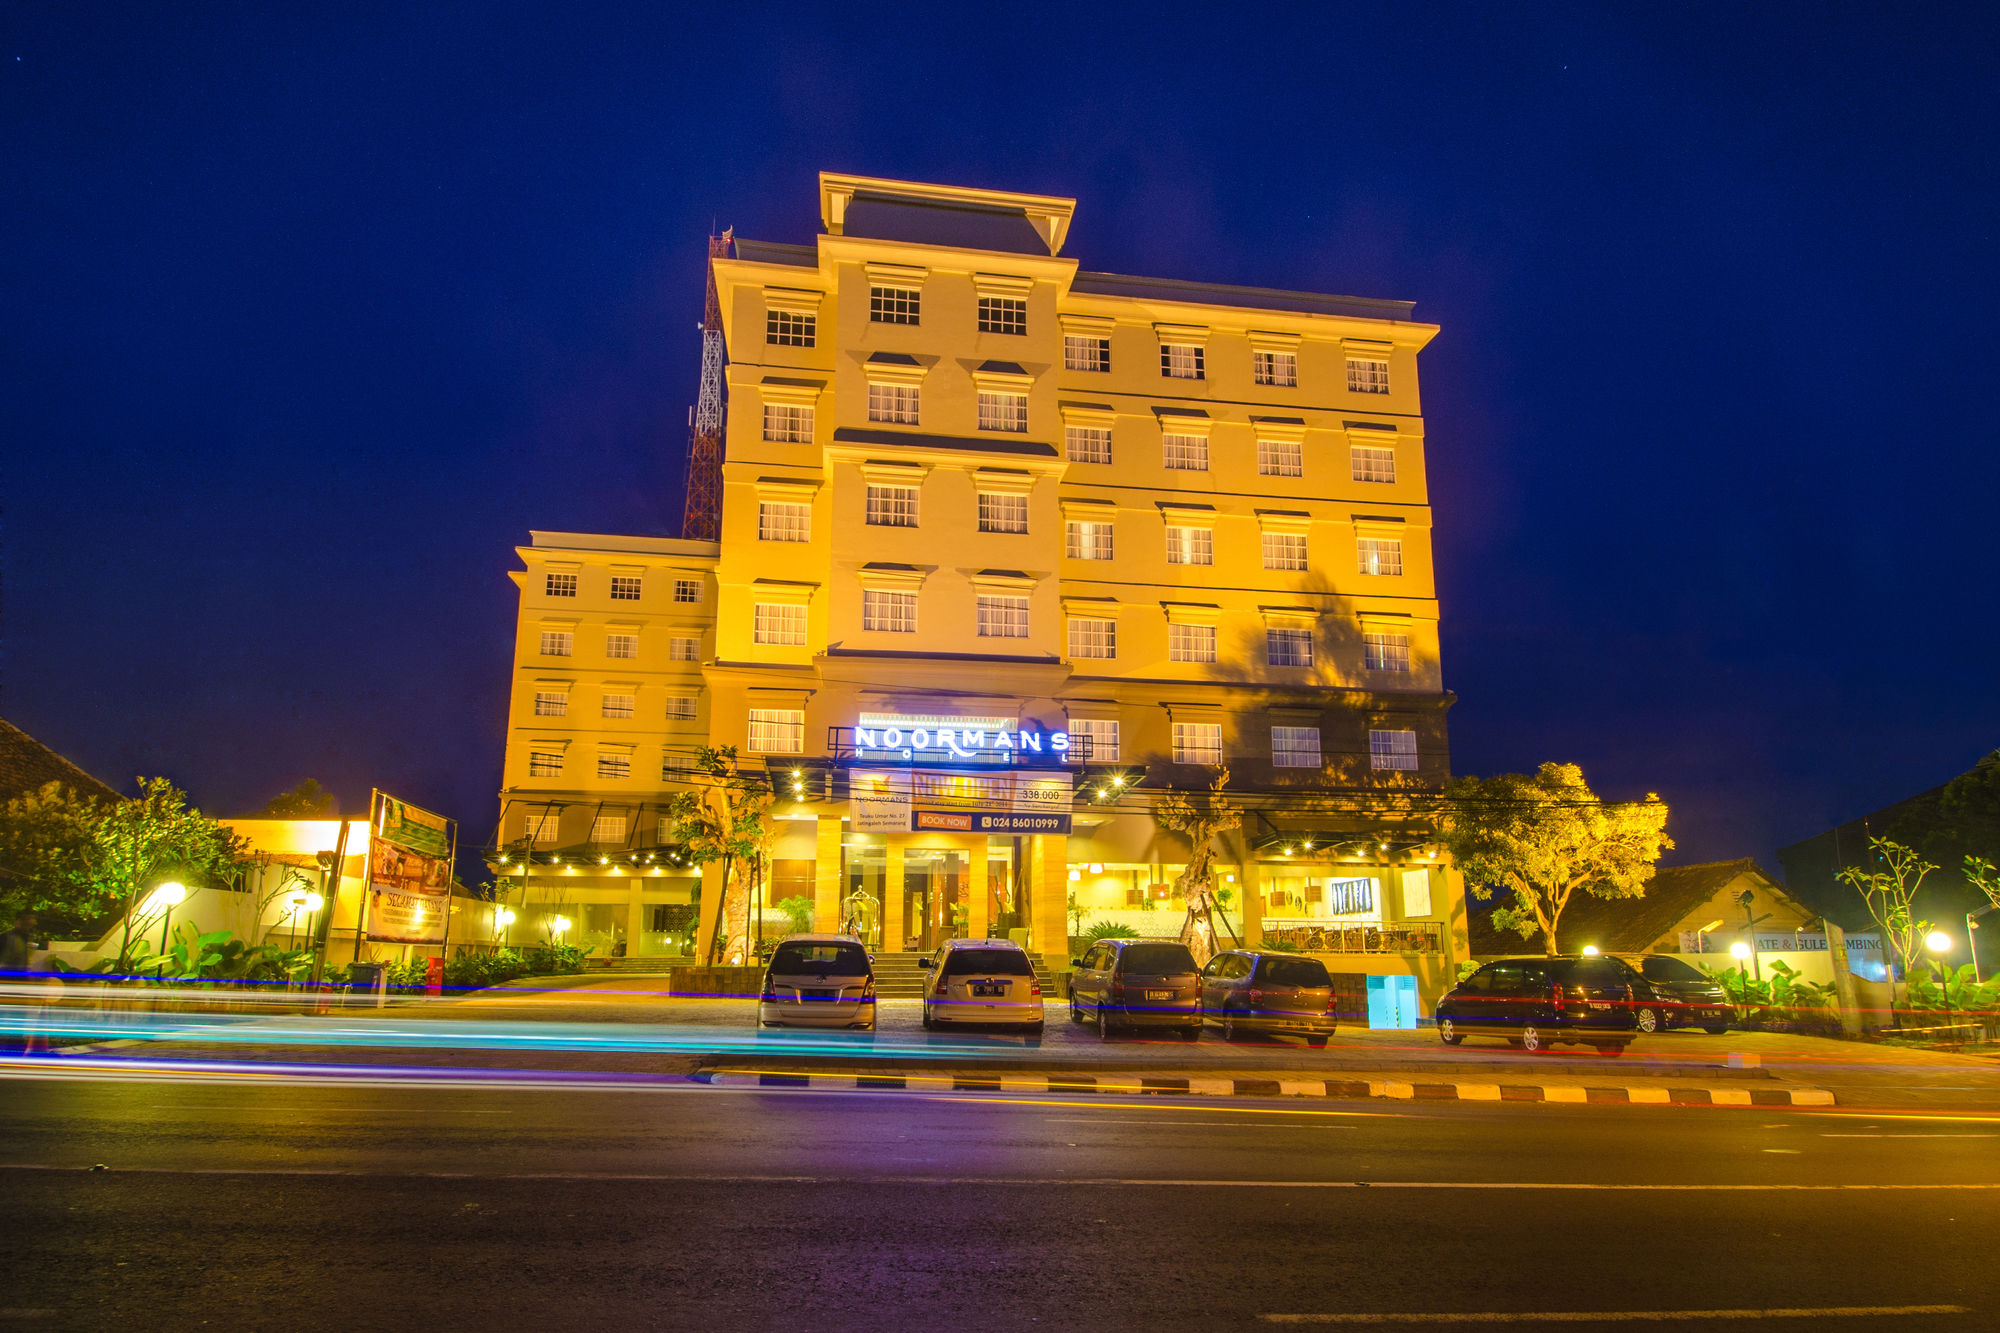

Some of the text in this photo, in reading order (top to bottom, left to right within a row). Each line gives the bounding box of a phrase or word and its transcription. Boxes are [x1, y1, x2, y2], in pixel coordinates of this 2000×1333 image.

[854, 726, 1070, 757] NOORMANS
[855, 748, 1068, 763] HOTEL
[914, 775, 1011, 800] NOW OPEN
[855, 796, 908, 805] NOORMANS
[1022, 790, 1059, 800] 338.000
[921, 815, 969, 828] BOOK NOW
[992, 817, 1059, 829] 024 86010999
[1782, 939, 1792, 950] &
